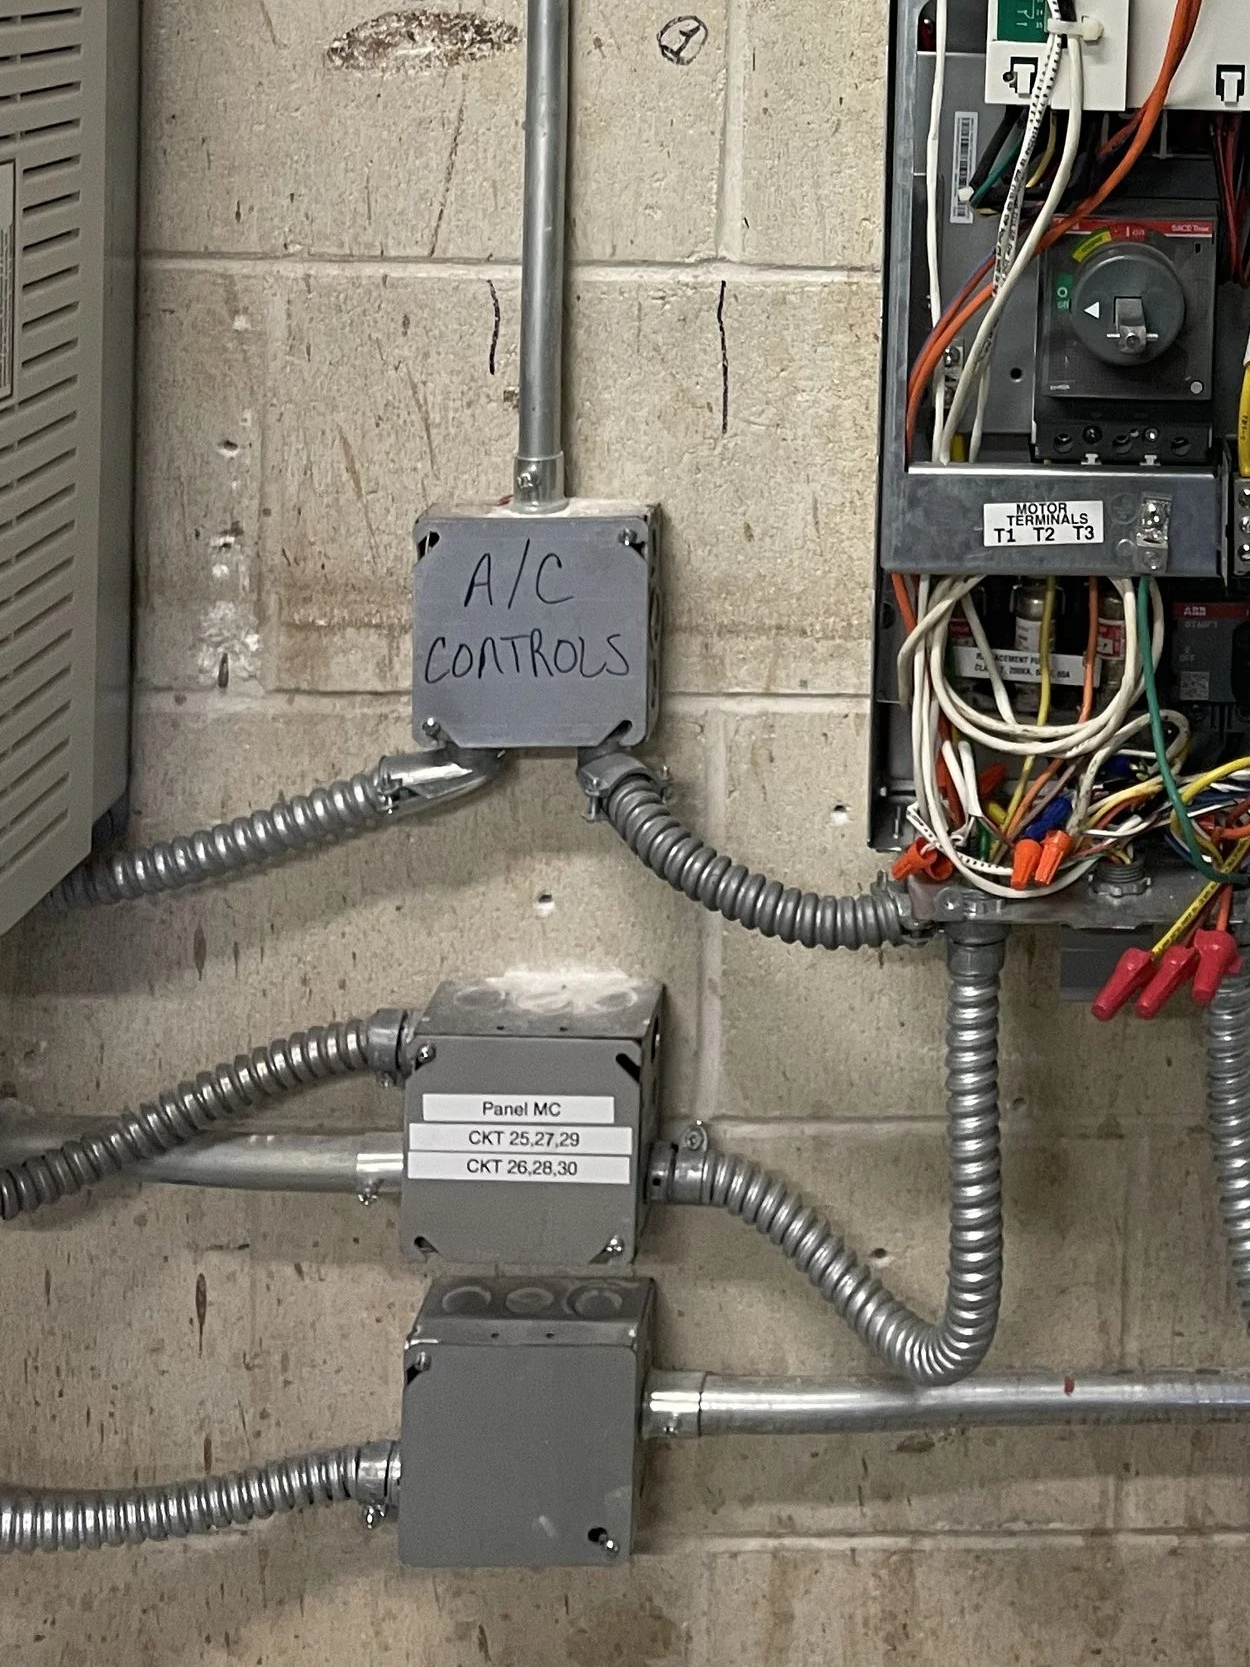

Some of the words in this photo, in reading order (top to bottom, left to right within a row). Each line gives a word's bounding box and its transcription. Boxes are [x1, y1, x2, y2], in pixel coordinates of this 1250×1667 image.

[1016, 502, 1067, 515] MOTOR
[1006, 513, 1089, 526] TERMINALS
[994, 528, 1016, 543] T1
[1033, 526, 1055, 542] T2
[1072, 525, 1095, 540] T3
[463, 537, 575, 610] A/C
[1183, 606, 1207, 616] ABB
[424, 628, 630, 684] CONTROLS
[976, 652, 1029, 664] REACEMENT
[482, 1100, 529, 1117] Panel
[533, 1101, 562, 1117] MC
[468, 1130, 506, 1146] CKT
[509, 1131, 580, 1148] 25,27,29
[466, 1159, 503, 1174] CKT
[507, 1159, 578, 1176] 26,28,30
